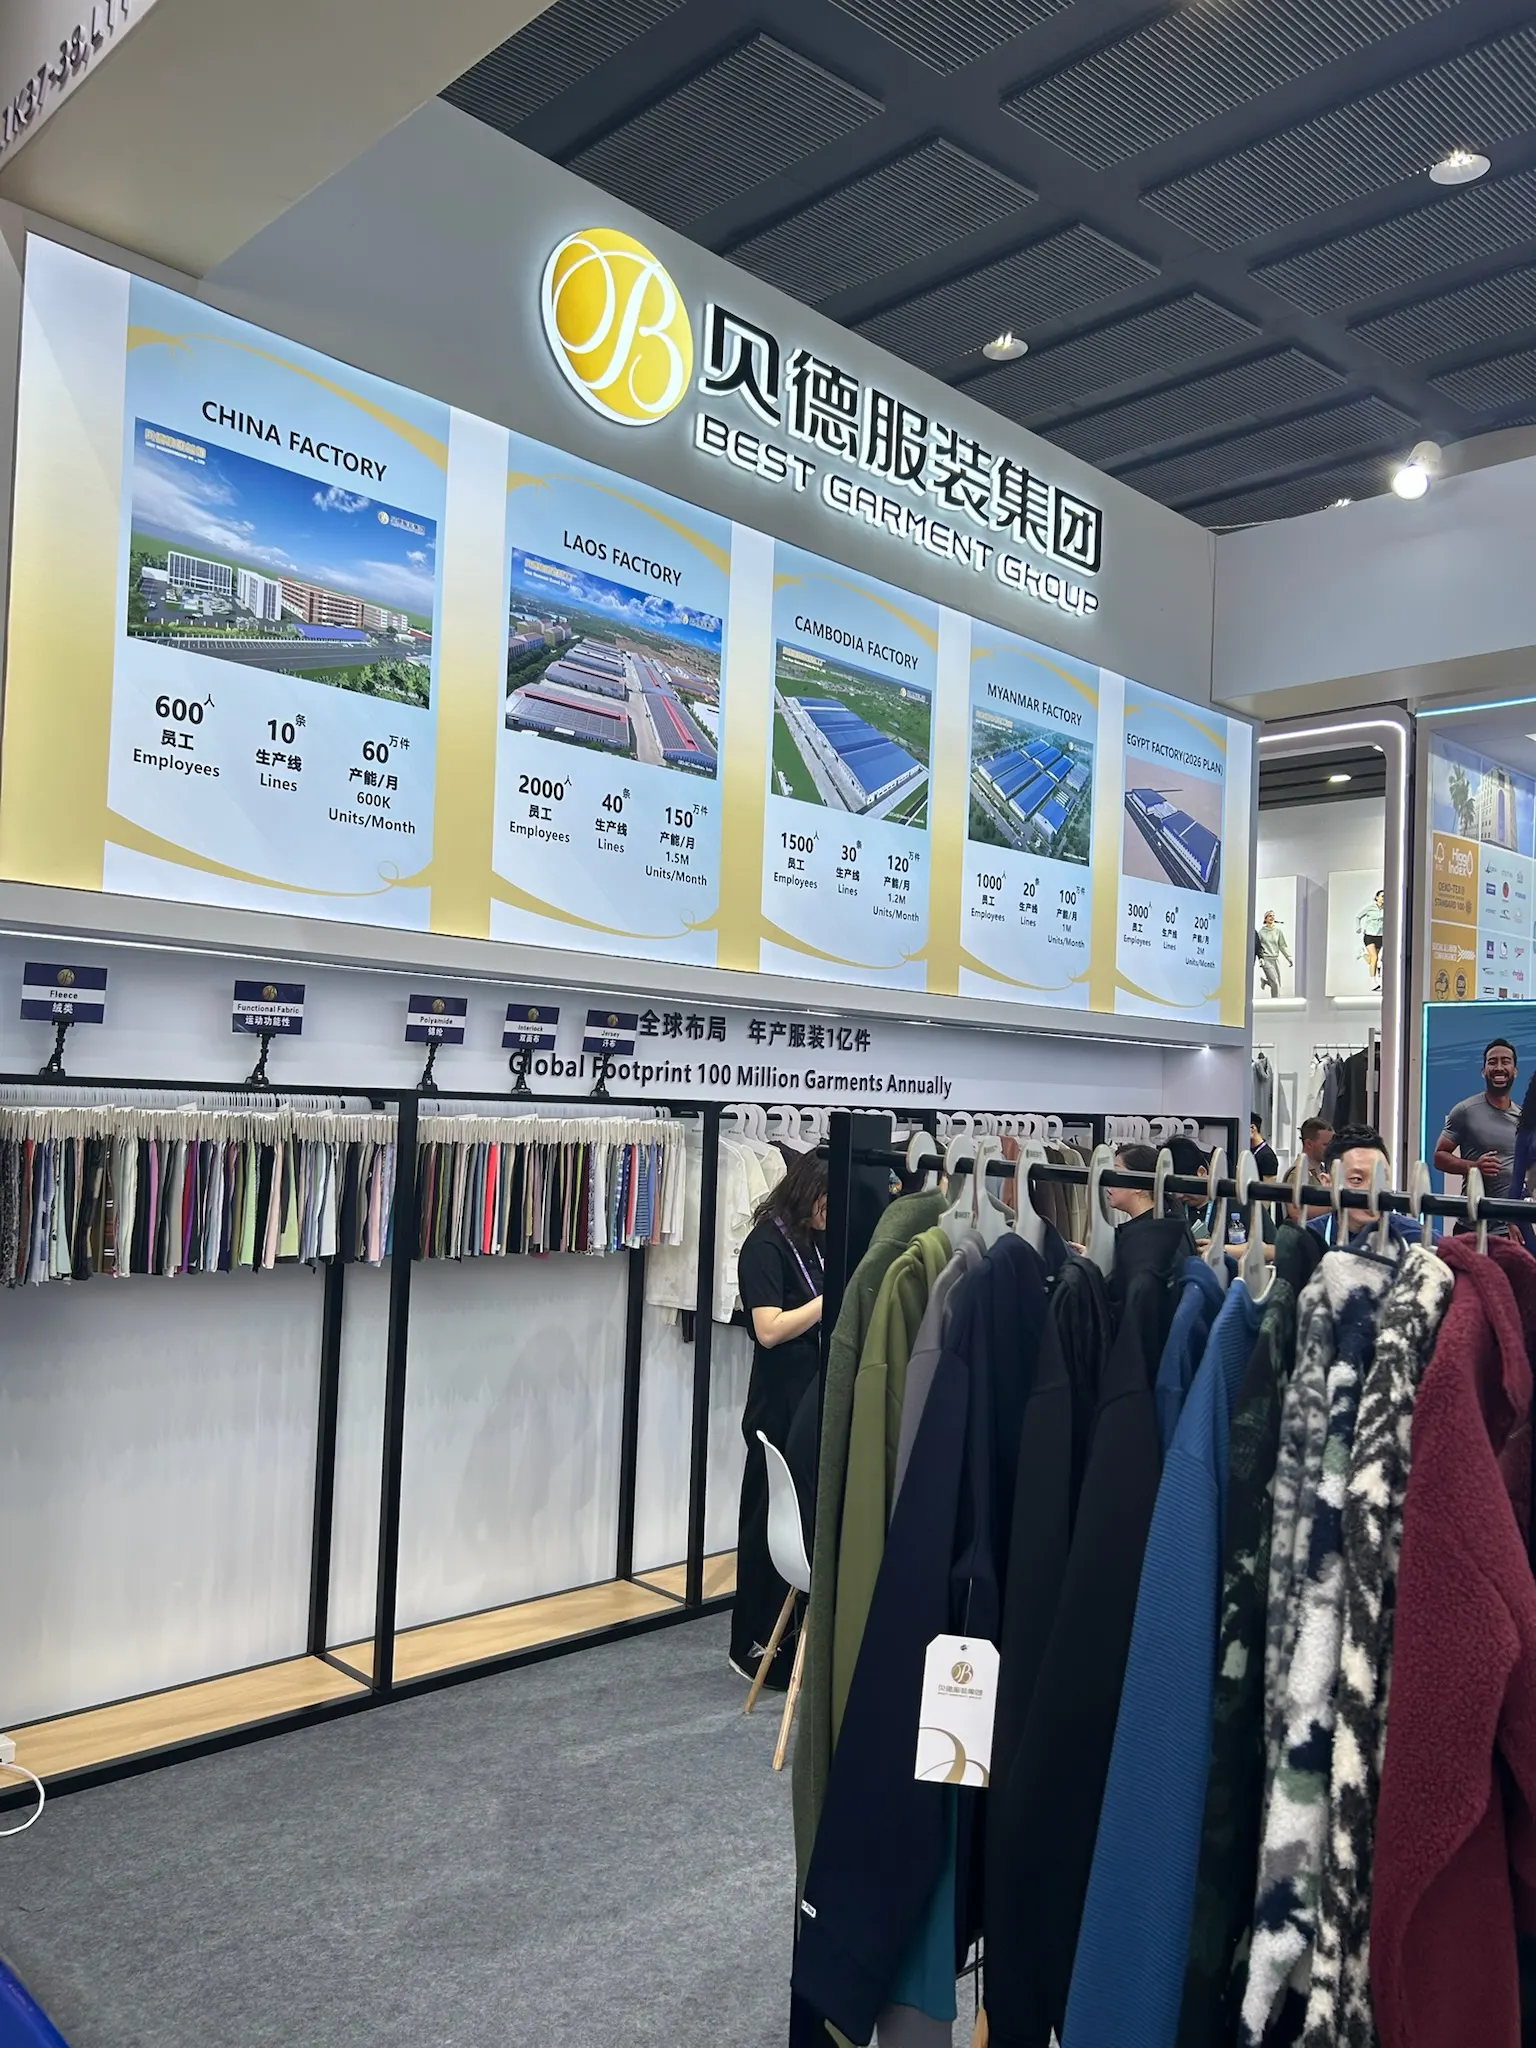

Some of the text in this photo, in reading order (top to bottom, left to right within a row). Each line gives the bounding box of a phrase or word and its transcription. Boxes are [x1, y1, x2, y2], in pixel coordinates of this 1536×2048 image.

[201, 401, 281, 446] CHINA
[289, 431, 388, 482] FACTORY
[698, 303, 1103, 577] 贝德服装集团
[695, 413, 1100, 617] BEST GARMENT GROUP
[563, 530, 607, 560] LAOS
[612, 547, 682, 588] FACTORY
[794, 615, 865, 652] CAMBODIA
[867, 638, 919, 671] FACTORY
[987, 683, 1040, 713] MYANMAR
[1042, 700, 1082, 727] FACTORY
[160, 729, 194, 752] 员工
[1126, 733, 1150, 751] EGYPT
[133, 748, 221, 778] Employees
[255, 749, 303, 773] 生产线
[259, 774, 298, 793] Lines
[348, 767, 399, 791] 产能/月
[357, 793, 392, 810] 600K
[328, 808, 416, 835] Units/Month
[529, 804, 553, 822] 员工
[509, 820, 571, 844] Employees
[595, 818, 628, 837] 生产线
[598, 838, 625, 854] Lines
[659, 831, 695, 849] 产能/月
[665, 851, 690, 866] 1.5M
[787, 857, 805, 871] 员工
[645, 865, 708, 886] Units/Month
[773, 872, 818, 890] Employees
[835, 867, 860, 882] 生产线
[837, 883, 858, 897] Lines
[888, 892, 906, 905] 1.2M
[982, 895, 995, 907] 员工
[1018, 902, 1038, 915] 生产线
[873, 906, 919, 923] Units/Month
[971, 908, 1005, 923] Employees
[1020, 915, 1036, 928] Lines
[1047, 935, 1085, 949] Units/Month
[1123, 934, 1151, 948] Employees
[1163, 940, 1176, 952] Lines
[49, 990, 78, 1000] Fleece
[52, 1003, 74, 1014] 绒类
[237, 1003, 299, 1014] Functional Fabric
[244, 1015, 291, 1027] 运动功能性
[420, 1016, 453, 1026] Polyamide
[518, 1024, 544, 1033] Interlock
[601, 1029, 620, 1039] Jersey
[639, 1008, 871, 1052] 全球布局 年产服装1亿件
[509, 1052, 952, 1100] Global Footprint 100 Million Garments Annually
